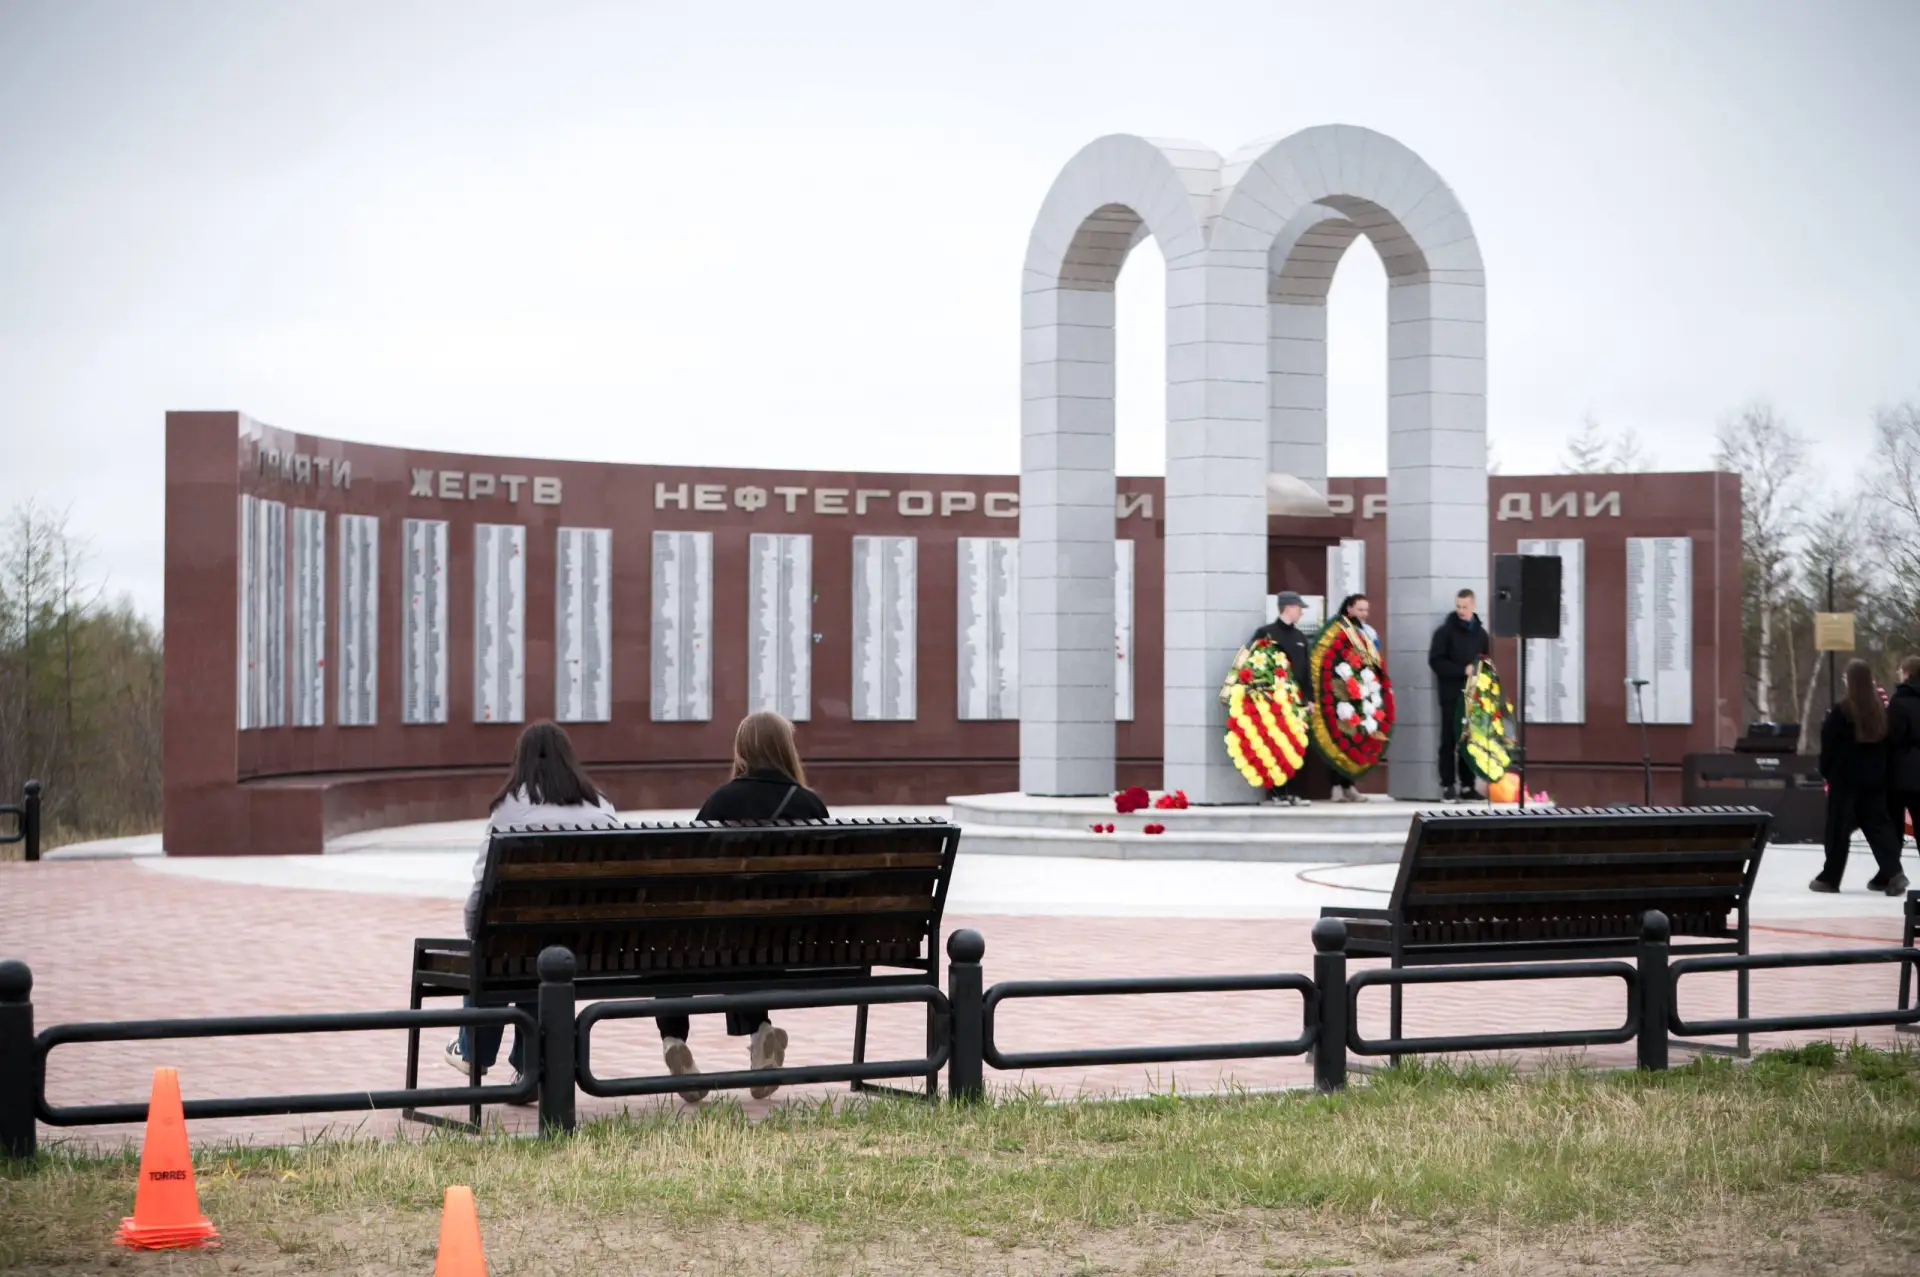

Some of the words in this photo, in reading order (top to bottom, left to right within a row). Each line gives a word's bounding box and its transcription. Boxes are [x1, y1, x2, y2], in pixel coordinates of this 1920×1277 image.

[410, 467, 563, 504] ЖЕРТВ
[653, 482, 1154, 520] НЕФТЕГОРСЙ
[149, 1170, 187, 1181] TORRES
